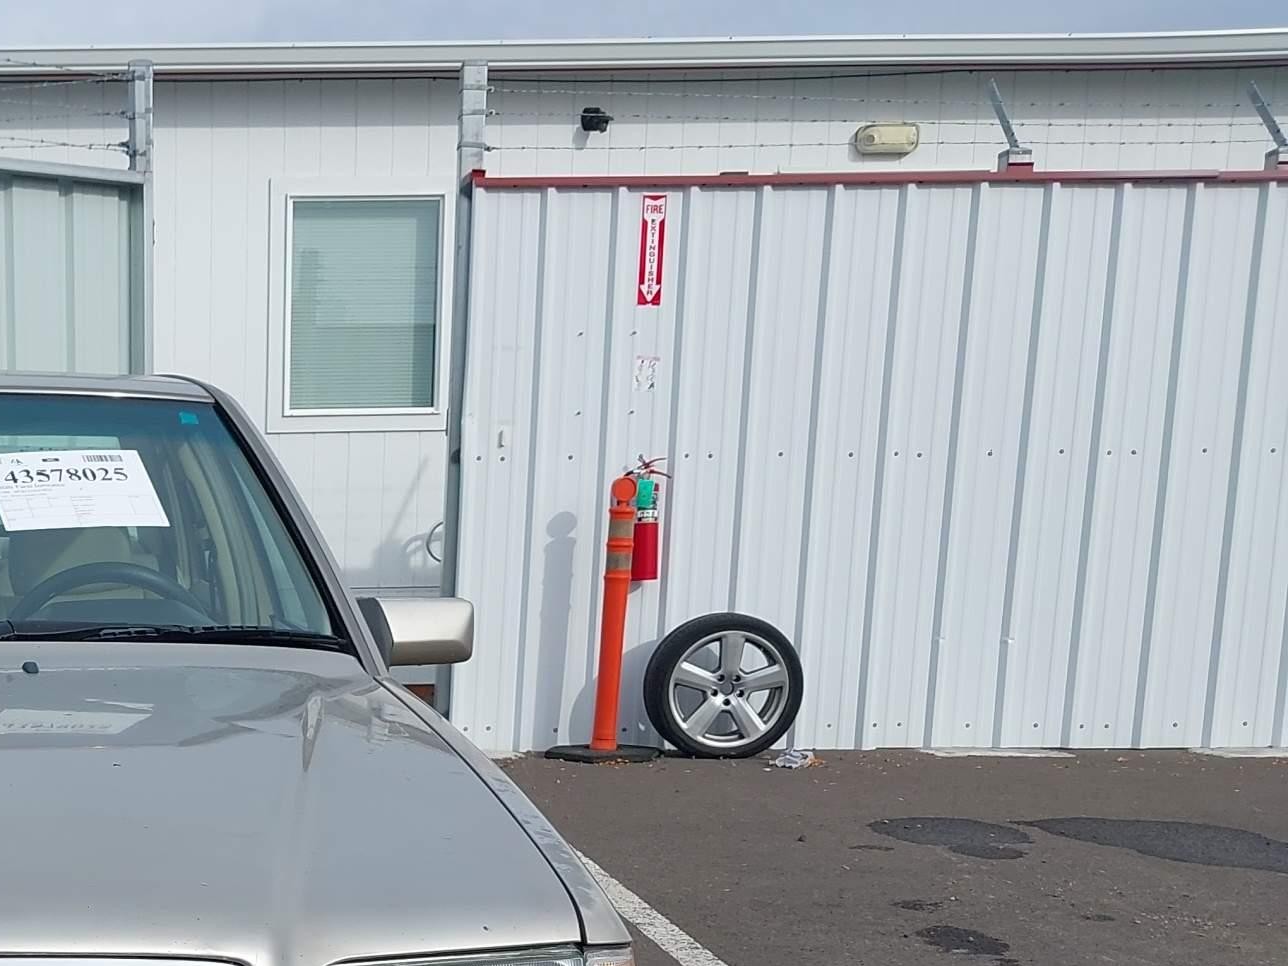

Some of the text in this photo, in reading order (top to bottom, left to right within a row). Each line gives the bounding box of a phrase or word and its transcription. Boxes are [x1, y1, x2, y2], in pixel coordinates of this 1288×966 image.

[646, 204, 664, 214] FIRE
[647, 218, 657, 296] EXTINGUISHER
[4, 467, 128, 484] 43578025
